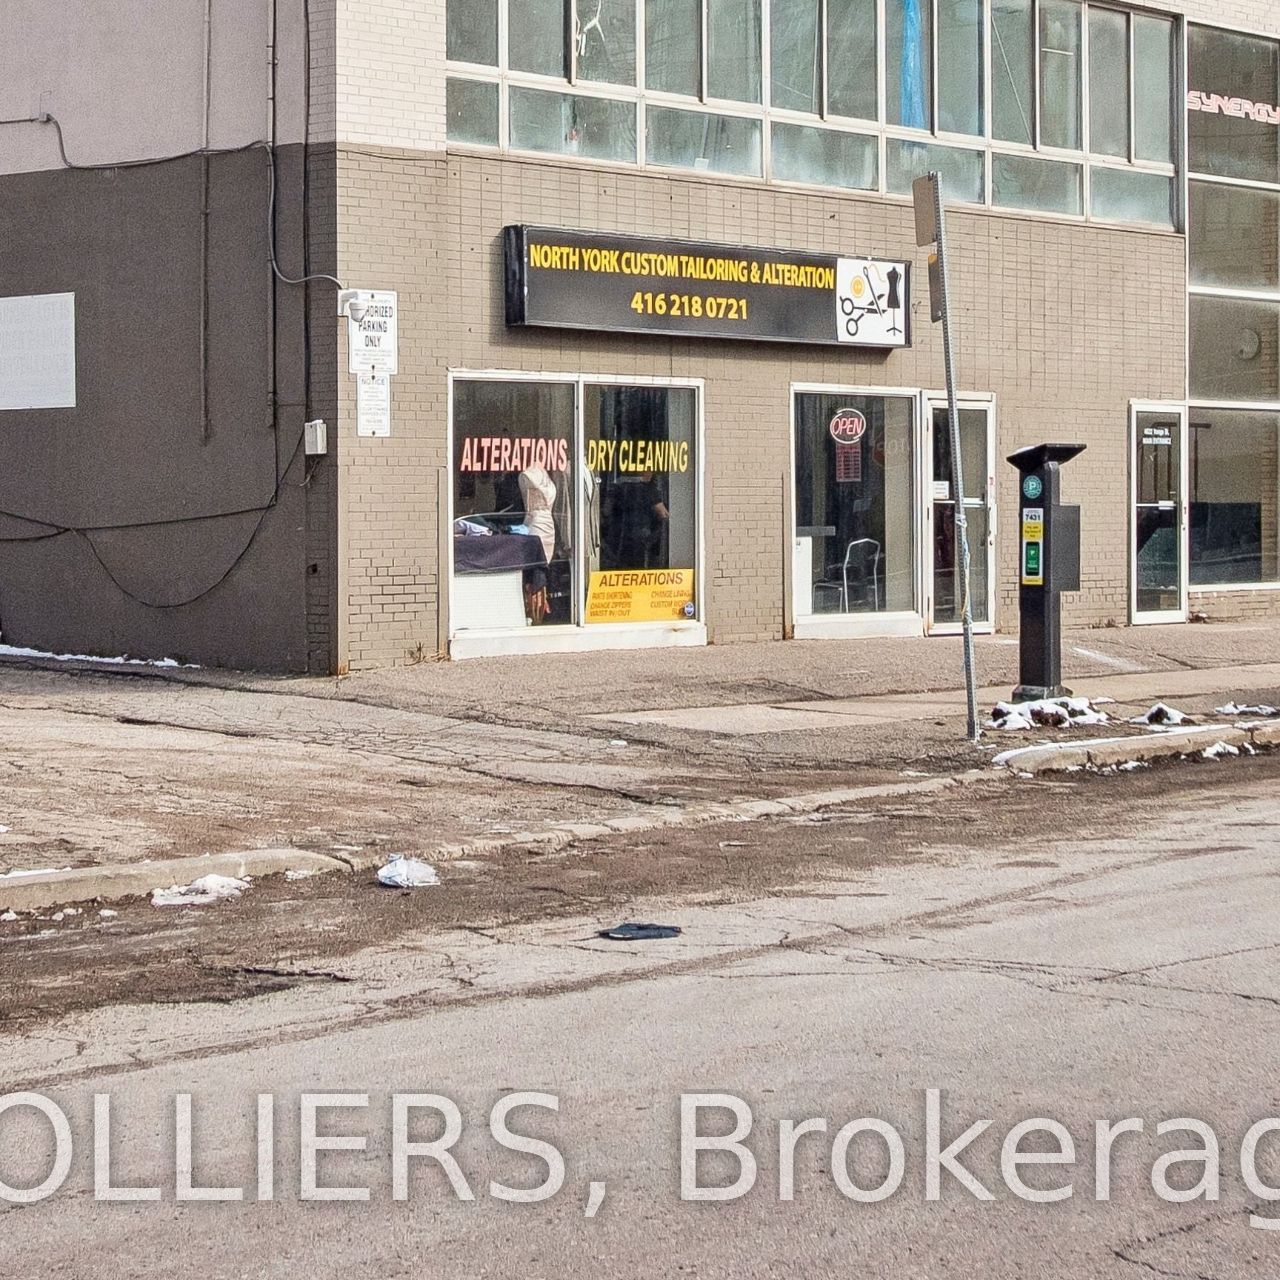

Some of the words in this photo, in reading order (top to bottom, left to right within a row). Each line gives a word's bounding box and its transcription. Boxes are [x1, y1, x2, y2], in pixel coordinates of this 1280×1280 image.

[529, 244, 579, 270] NORTH
[581, 248, 620, 273] YORK
[621, 251, 679, 277] CUSTOM
[680, 255, 748, 283] TAILORING
[750, 261, 761, 284] &
[762, 262, 834, 290] ALTERATION
[631, 291, 667, 316] 416
[670, 294, 703, 318] 218
[705, 297, 747, 320] 0721
[358, 320, 388, 333] PARKING
[364, 335, 382, 348] ONLY
[833, 417, 863, 435] OPEN
[459, 436, 569, 472] ALTERATIONS
[587, 438, 617, 472] DRY
[619, 440, 688, 473] CLEANING
[598, 572, 684, 587] ALTERATIONS
[650, 600, 673, 609] CUSTOM
